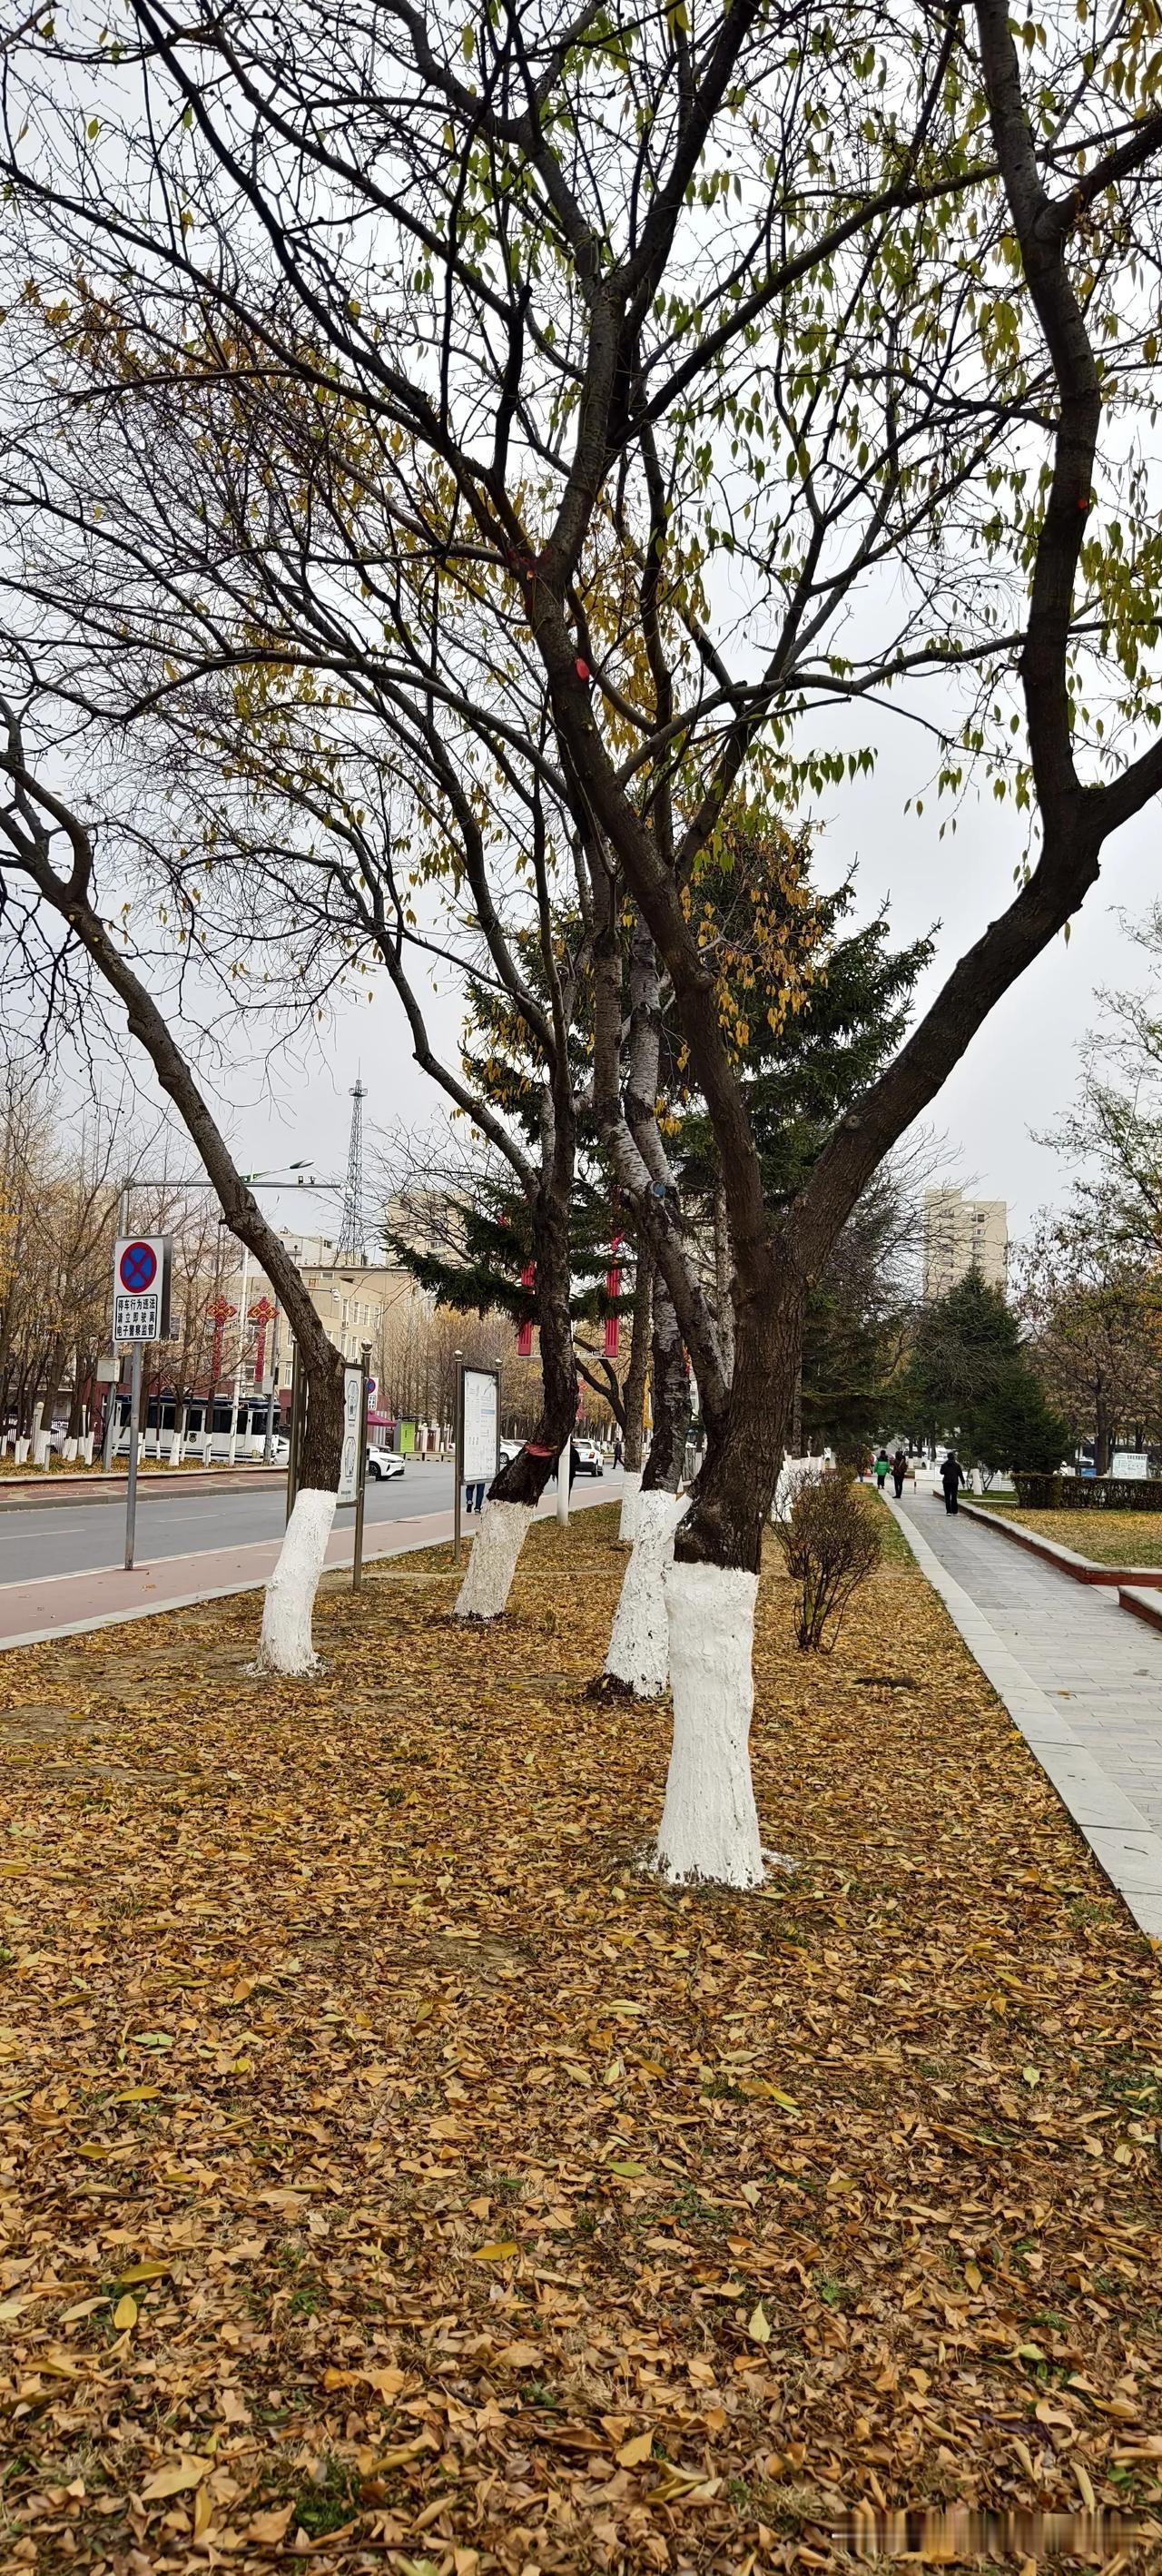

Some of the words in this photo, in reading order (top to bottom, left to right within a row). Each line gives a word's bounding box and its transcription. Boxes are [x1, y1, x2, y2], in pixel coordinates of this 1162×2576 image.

[118, 1298, 155, 1311] 停车行为违法
